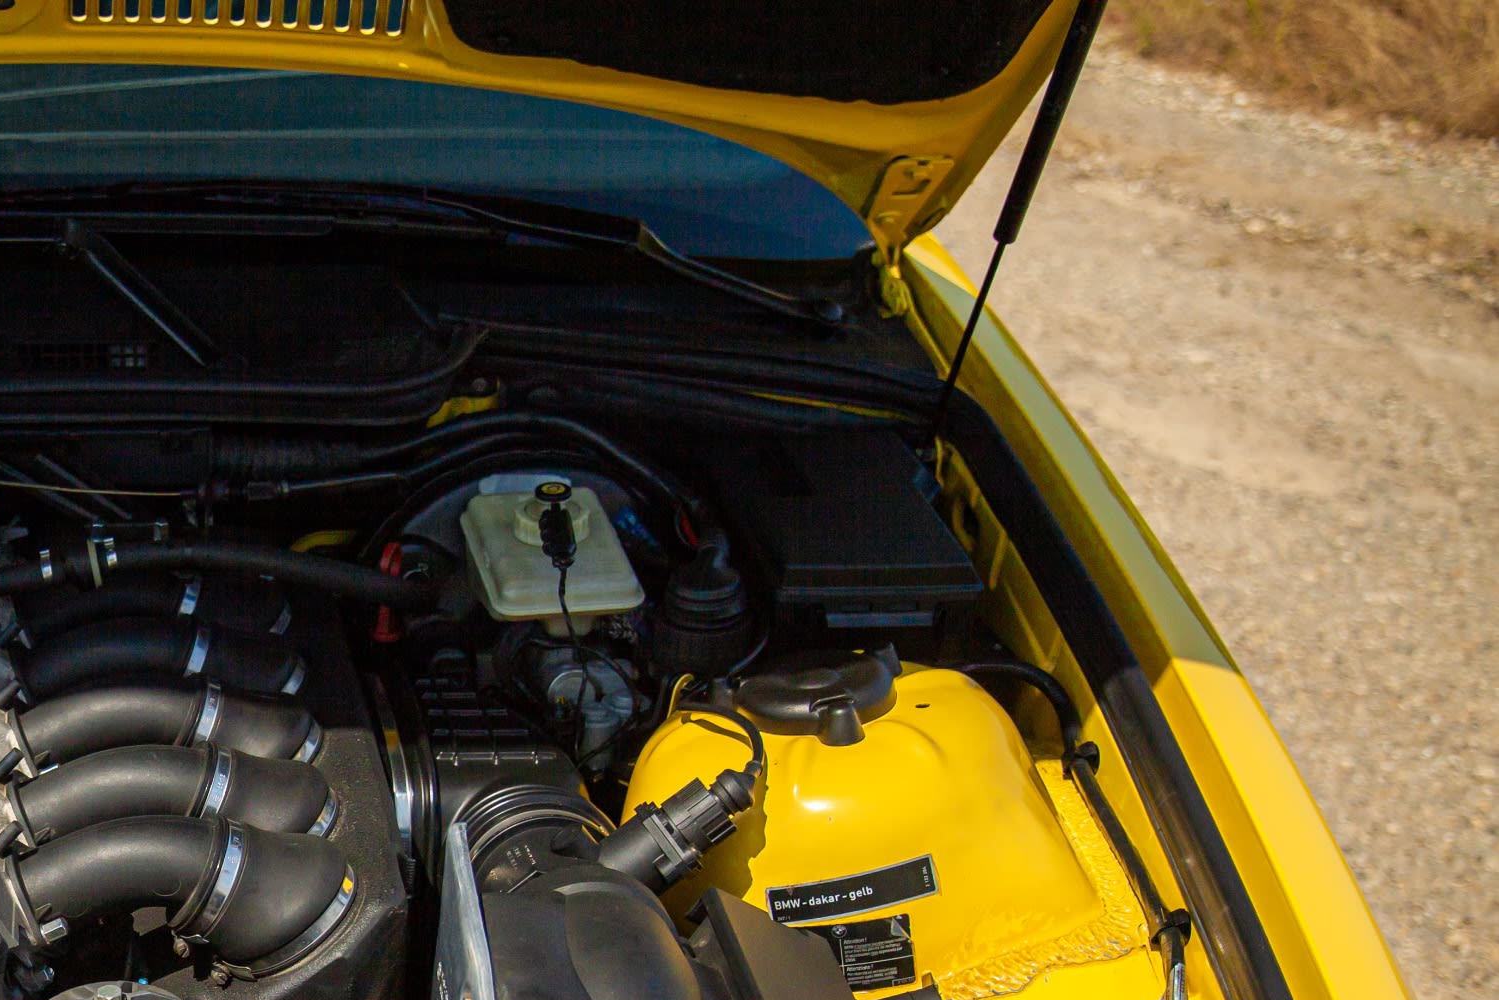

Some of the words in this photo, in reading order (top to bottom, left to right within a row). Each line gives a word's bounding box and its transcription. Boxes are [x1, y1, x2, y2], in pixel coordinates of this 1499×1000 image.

[774, 898, 801, 911] BMW
[808, 894, 841, 907] dakar
[848, 886, 874, 901] gelb
